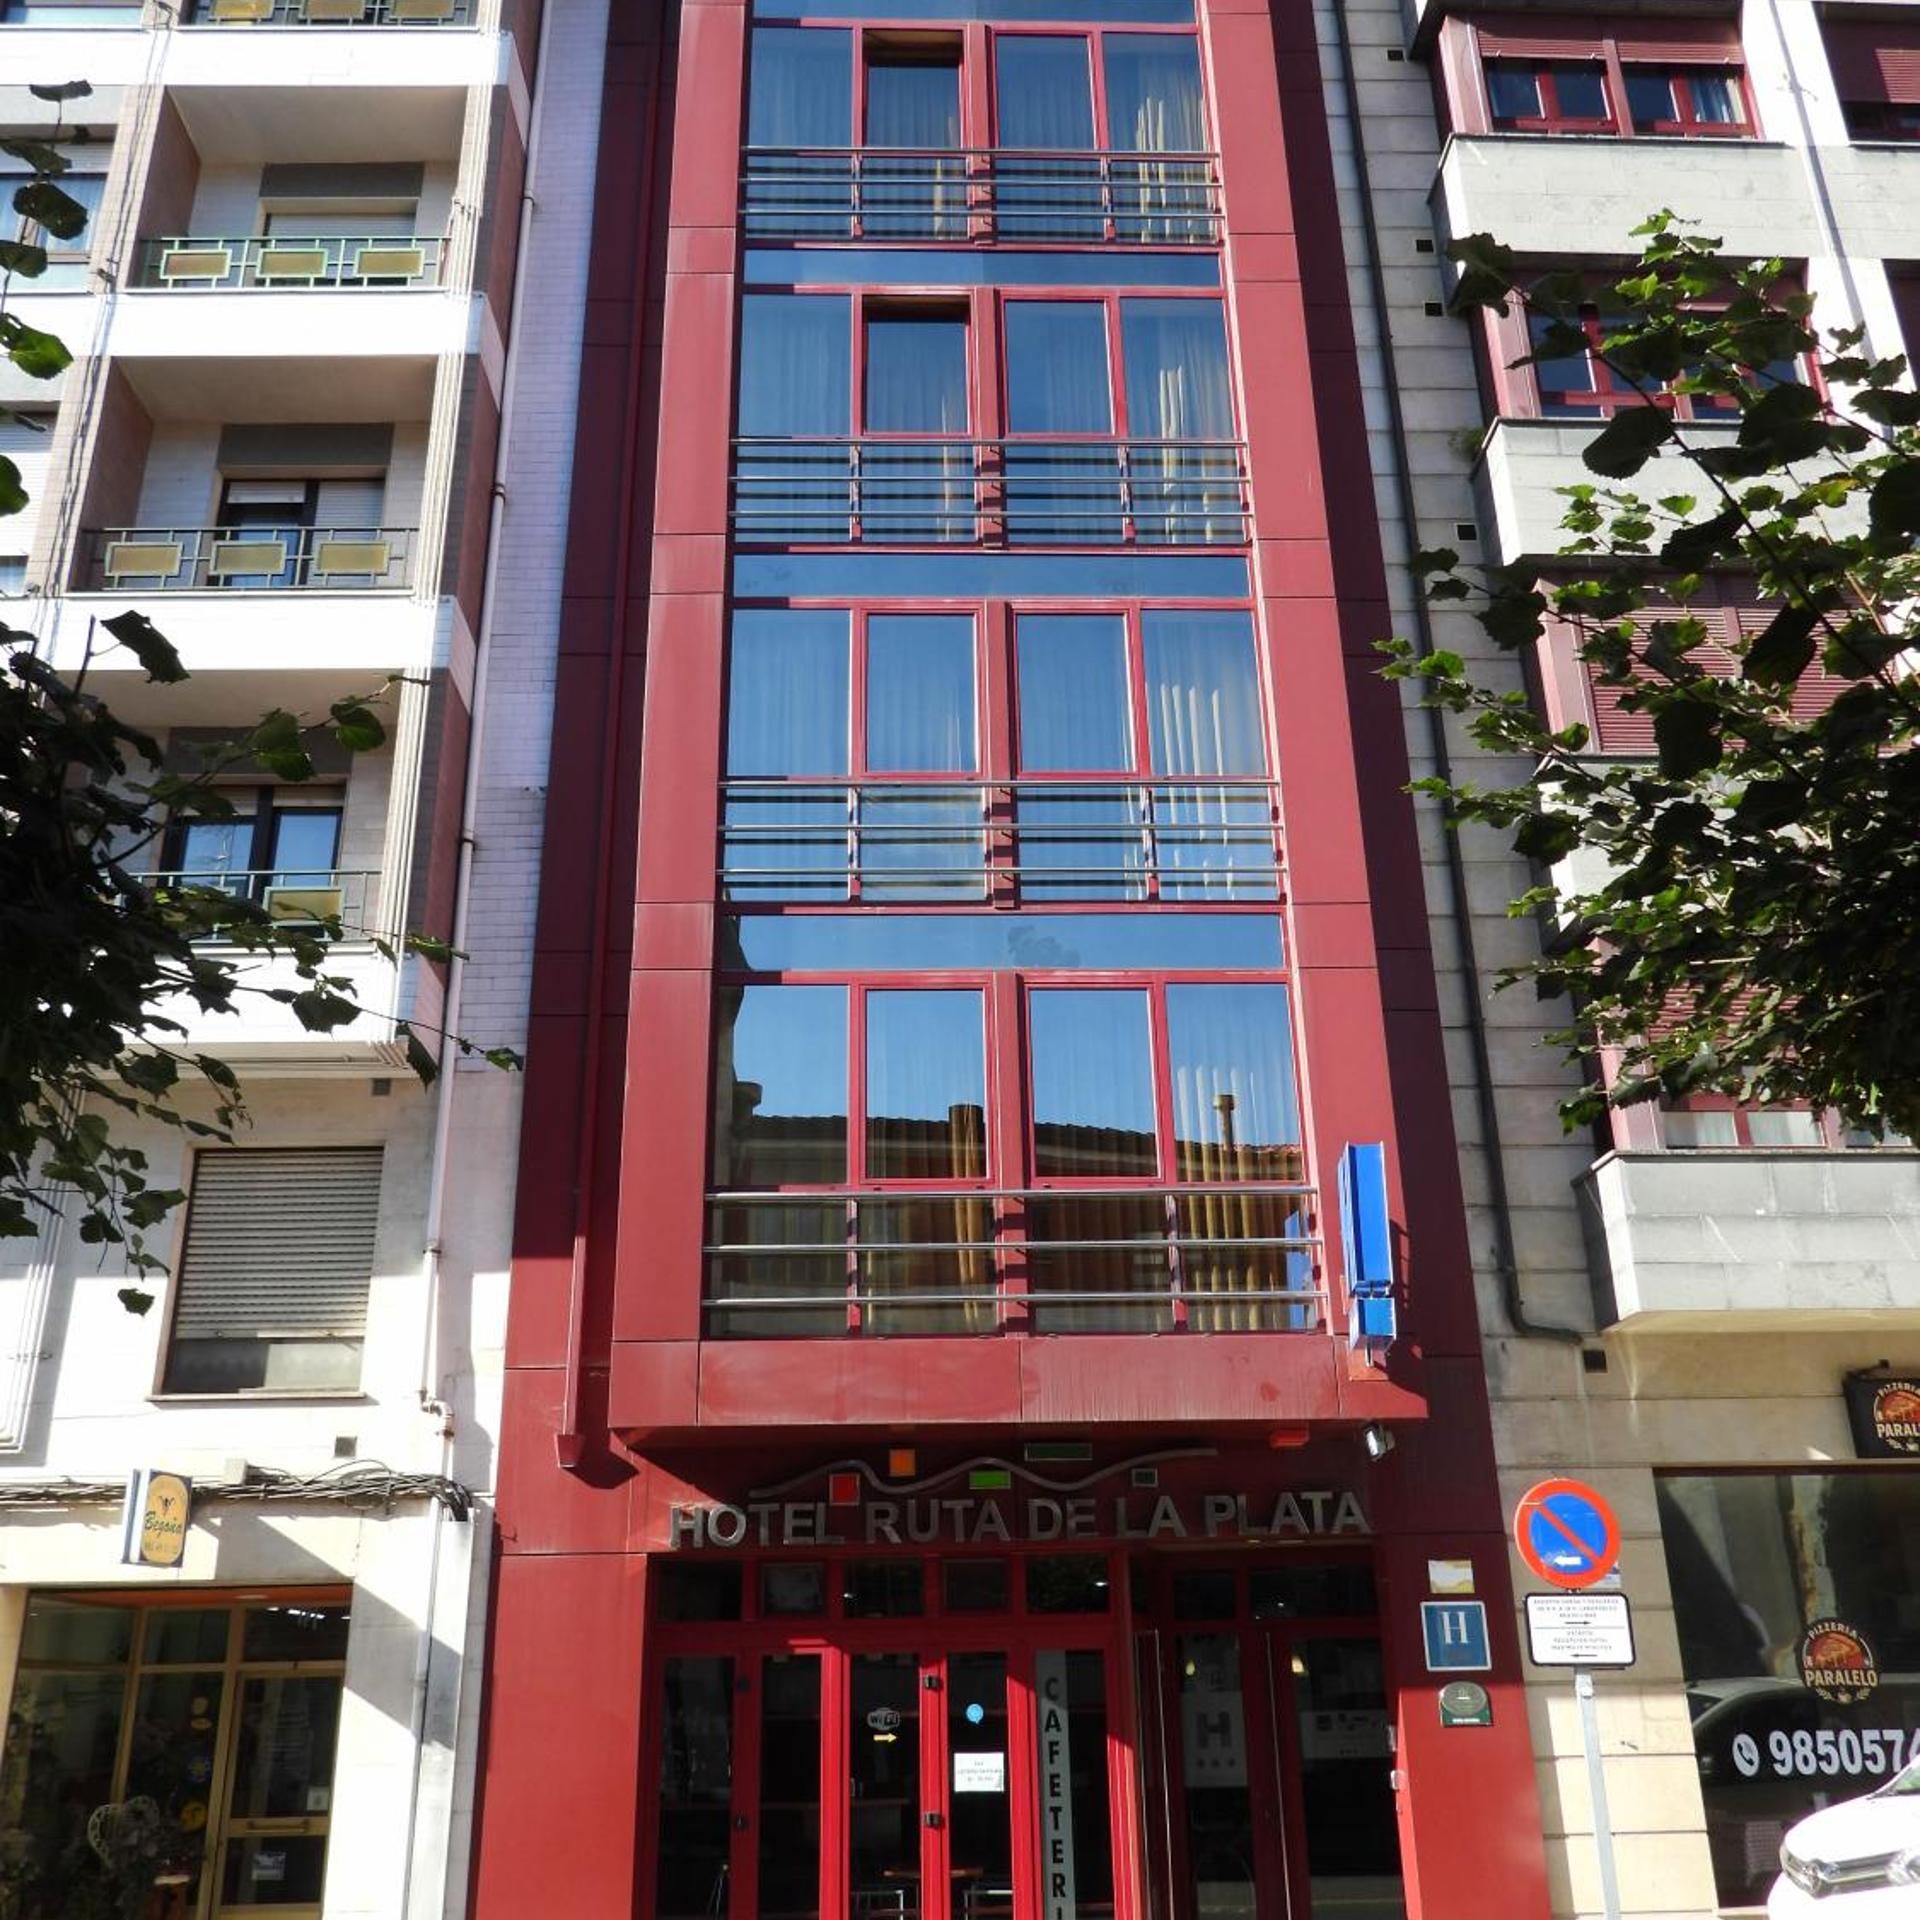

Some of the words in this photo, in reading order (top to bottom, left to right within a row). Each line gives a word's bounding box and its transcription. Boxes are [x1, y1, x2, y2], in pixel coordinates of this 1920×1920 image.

[1877, 1423, 1920, 1438] PARAL
[670, 1502, 846, 1550] HOTEL
[864, 1499, 1011, 1545] RUTA
[1029, 1498, 1099, 1540] DE
[1116, 1495, 1187, 1538] LA
[1204, 1491, 1373, 1536] PLATA
[1441, 1611, 1469, 1644] H
[1808, 1622, 1858, 1640] PIZZERIA
[1805, 1668, 1878, 1688] PARALELO
[1768, 1729, 1920, 1776] 985057
